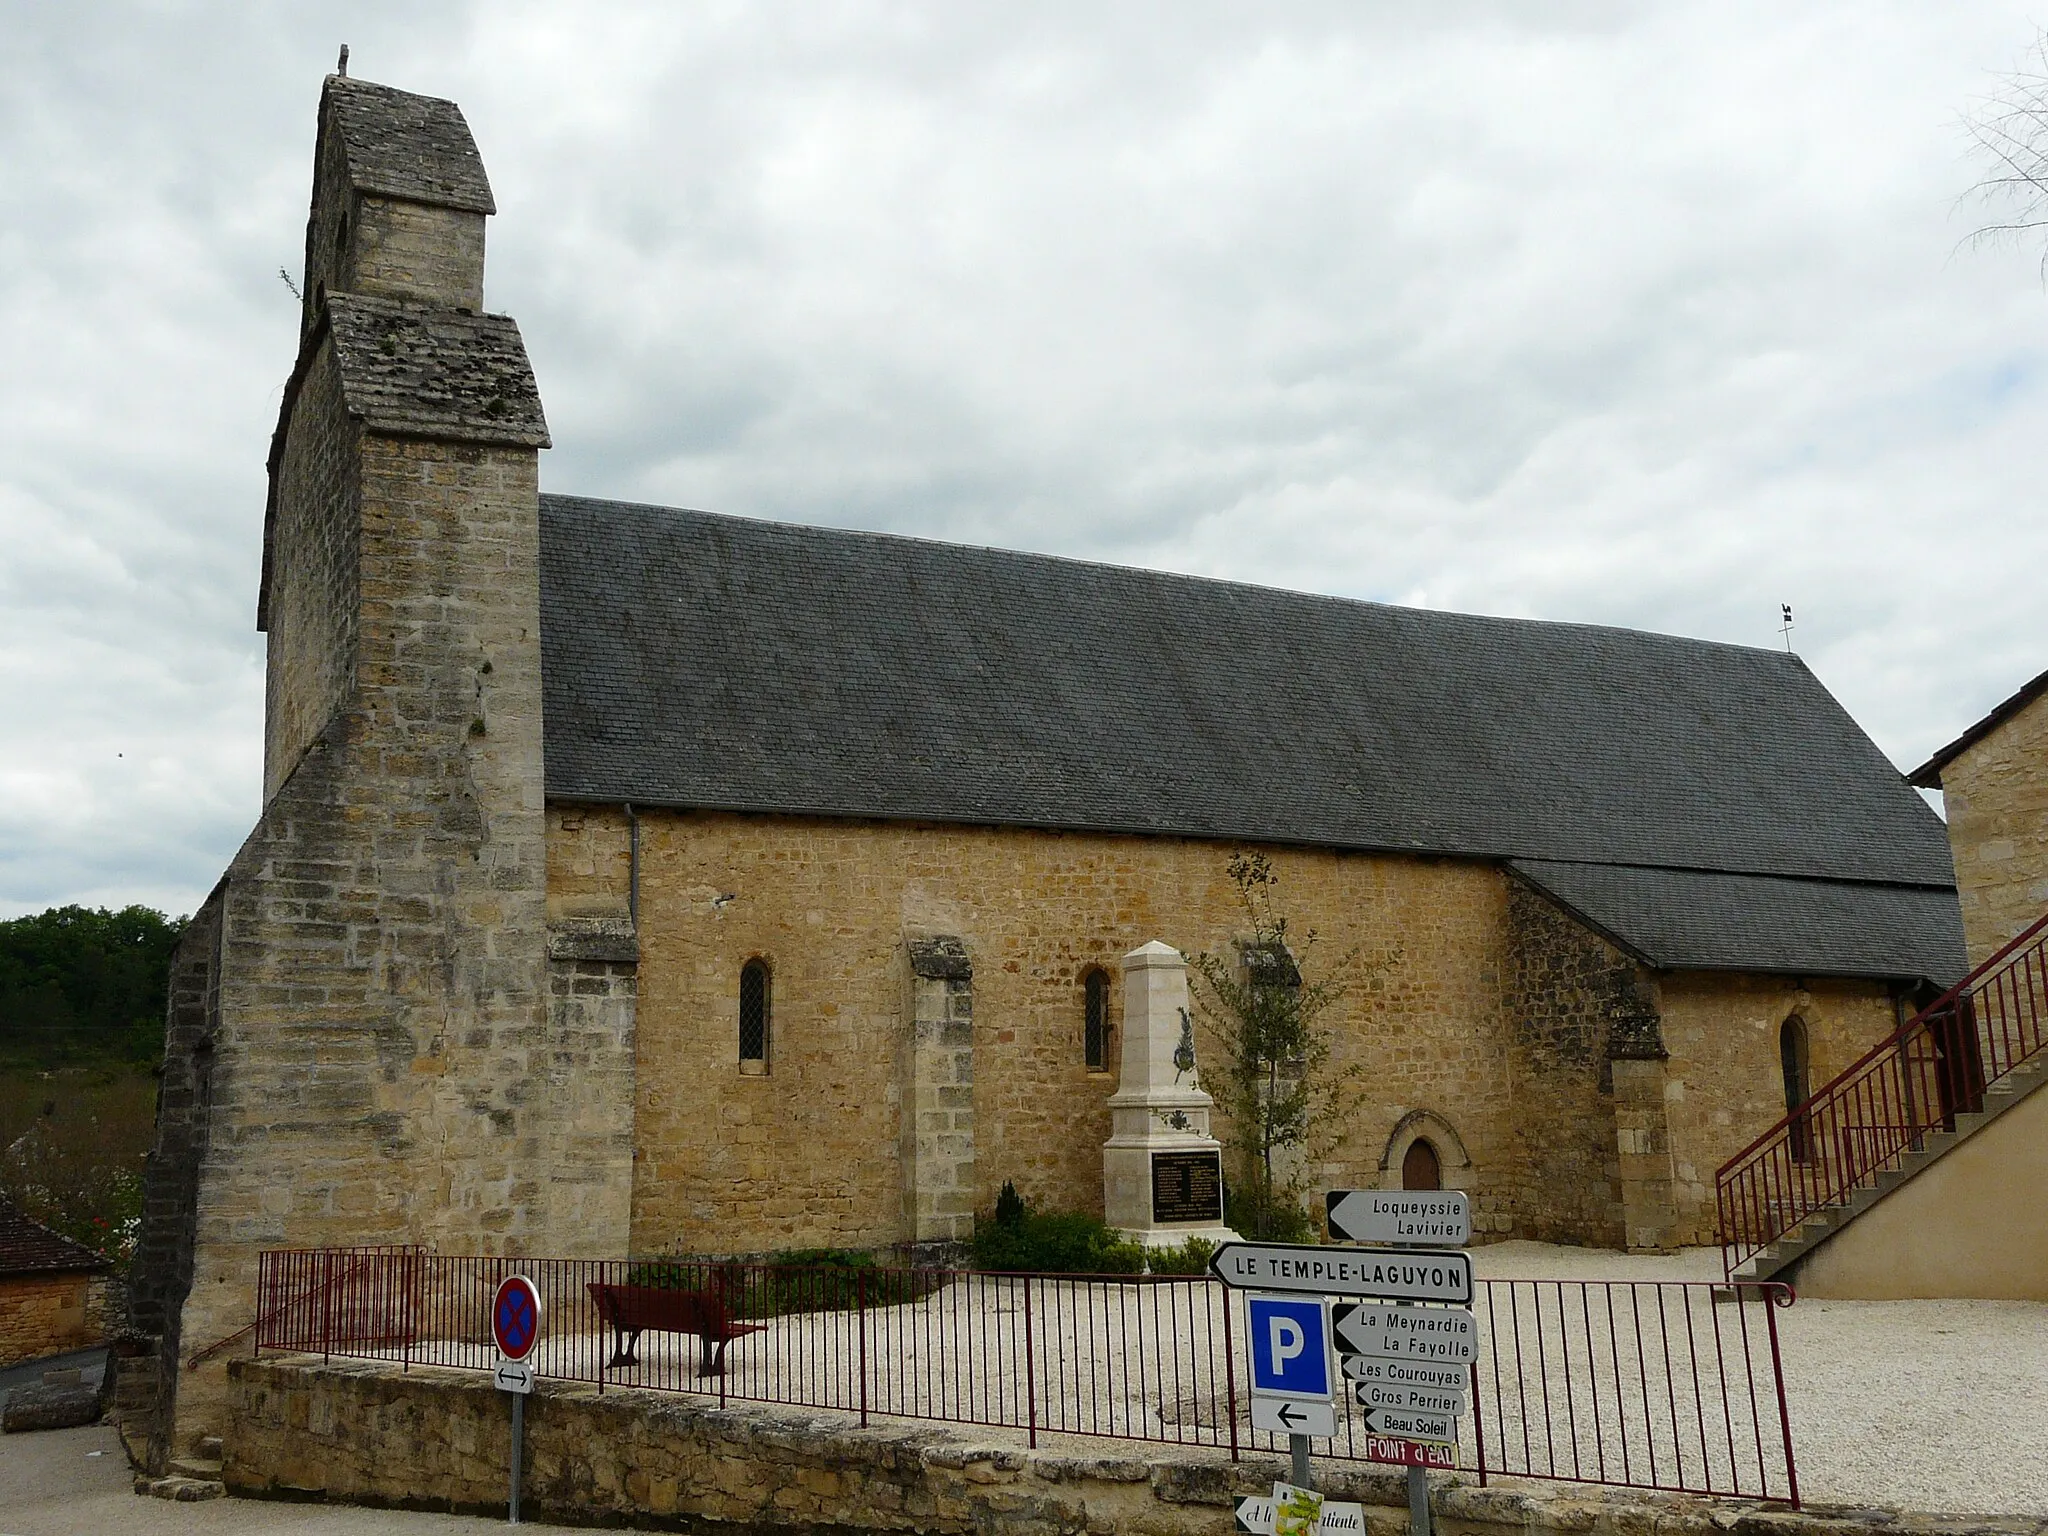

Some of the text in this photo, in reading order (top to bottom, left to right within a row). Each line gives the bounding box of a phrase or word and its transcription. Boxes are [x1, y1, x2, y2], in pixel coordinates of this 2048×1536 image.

[1373, 1199, 1461, 1217] Loqueyssie
[1398, 1220, 1462, 1236] Lavivier
[1236, 1257, 1461, 1288] LE TEMPLE-LAGUYON
[1361, 1311, 1468, 1333] La Meynardie
[1269, 1315, 1304, 1376] P
[1383, 1336, 1469, 1357] La Fayolle
[1360, 1361, 1461, 1386] Les Courouyas
[1371, 1388, 1457, 1410] Gros Perrier
[1384, 1415, 1447, 1436] Beau Soleil
[1368, 1438, 1405, 1460] POINT
